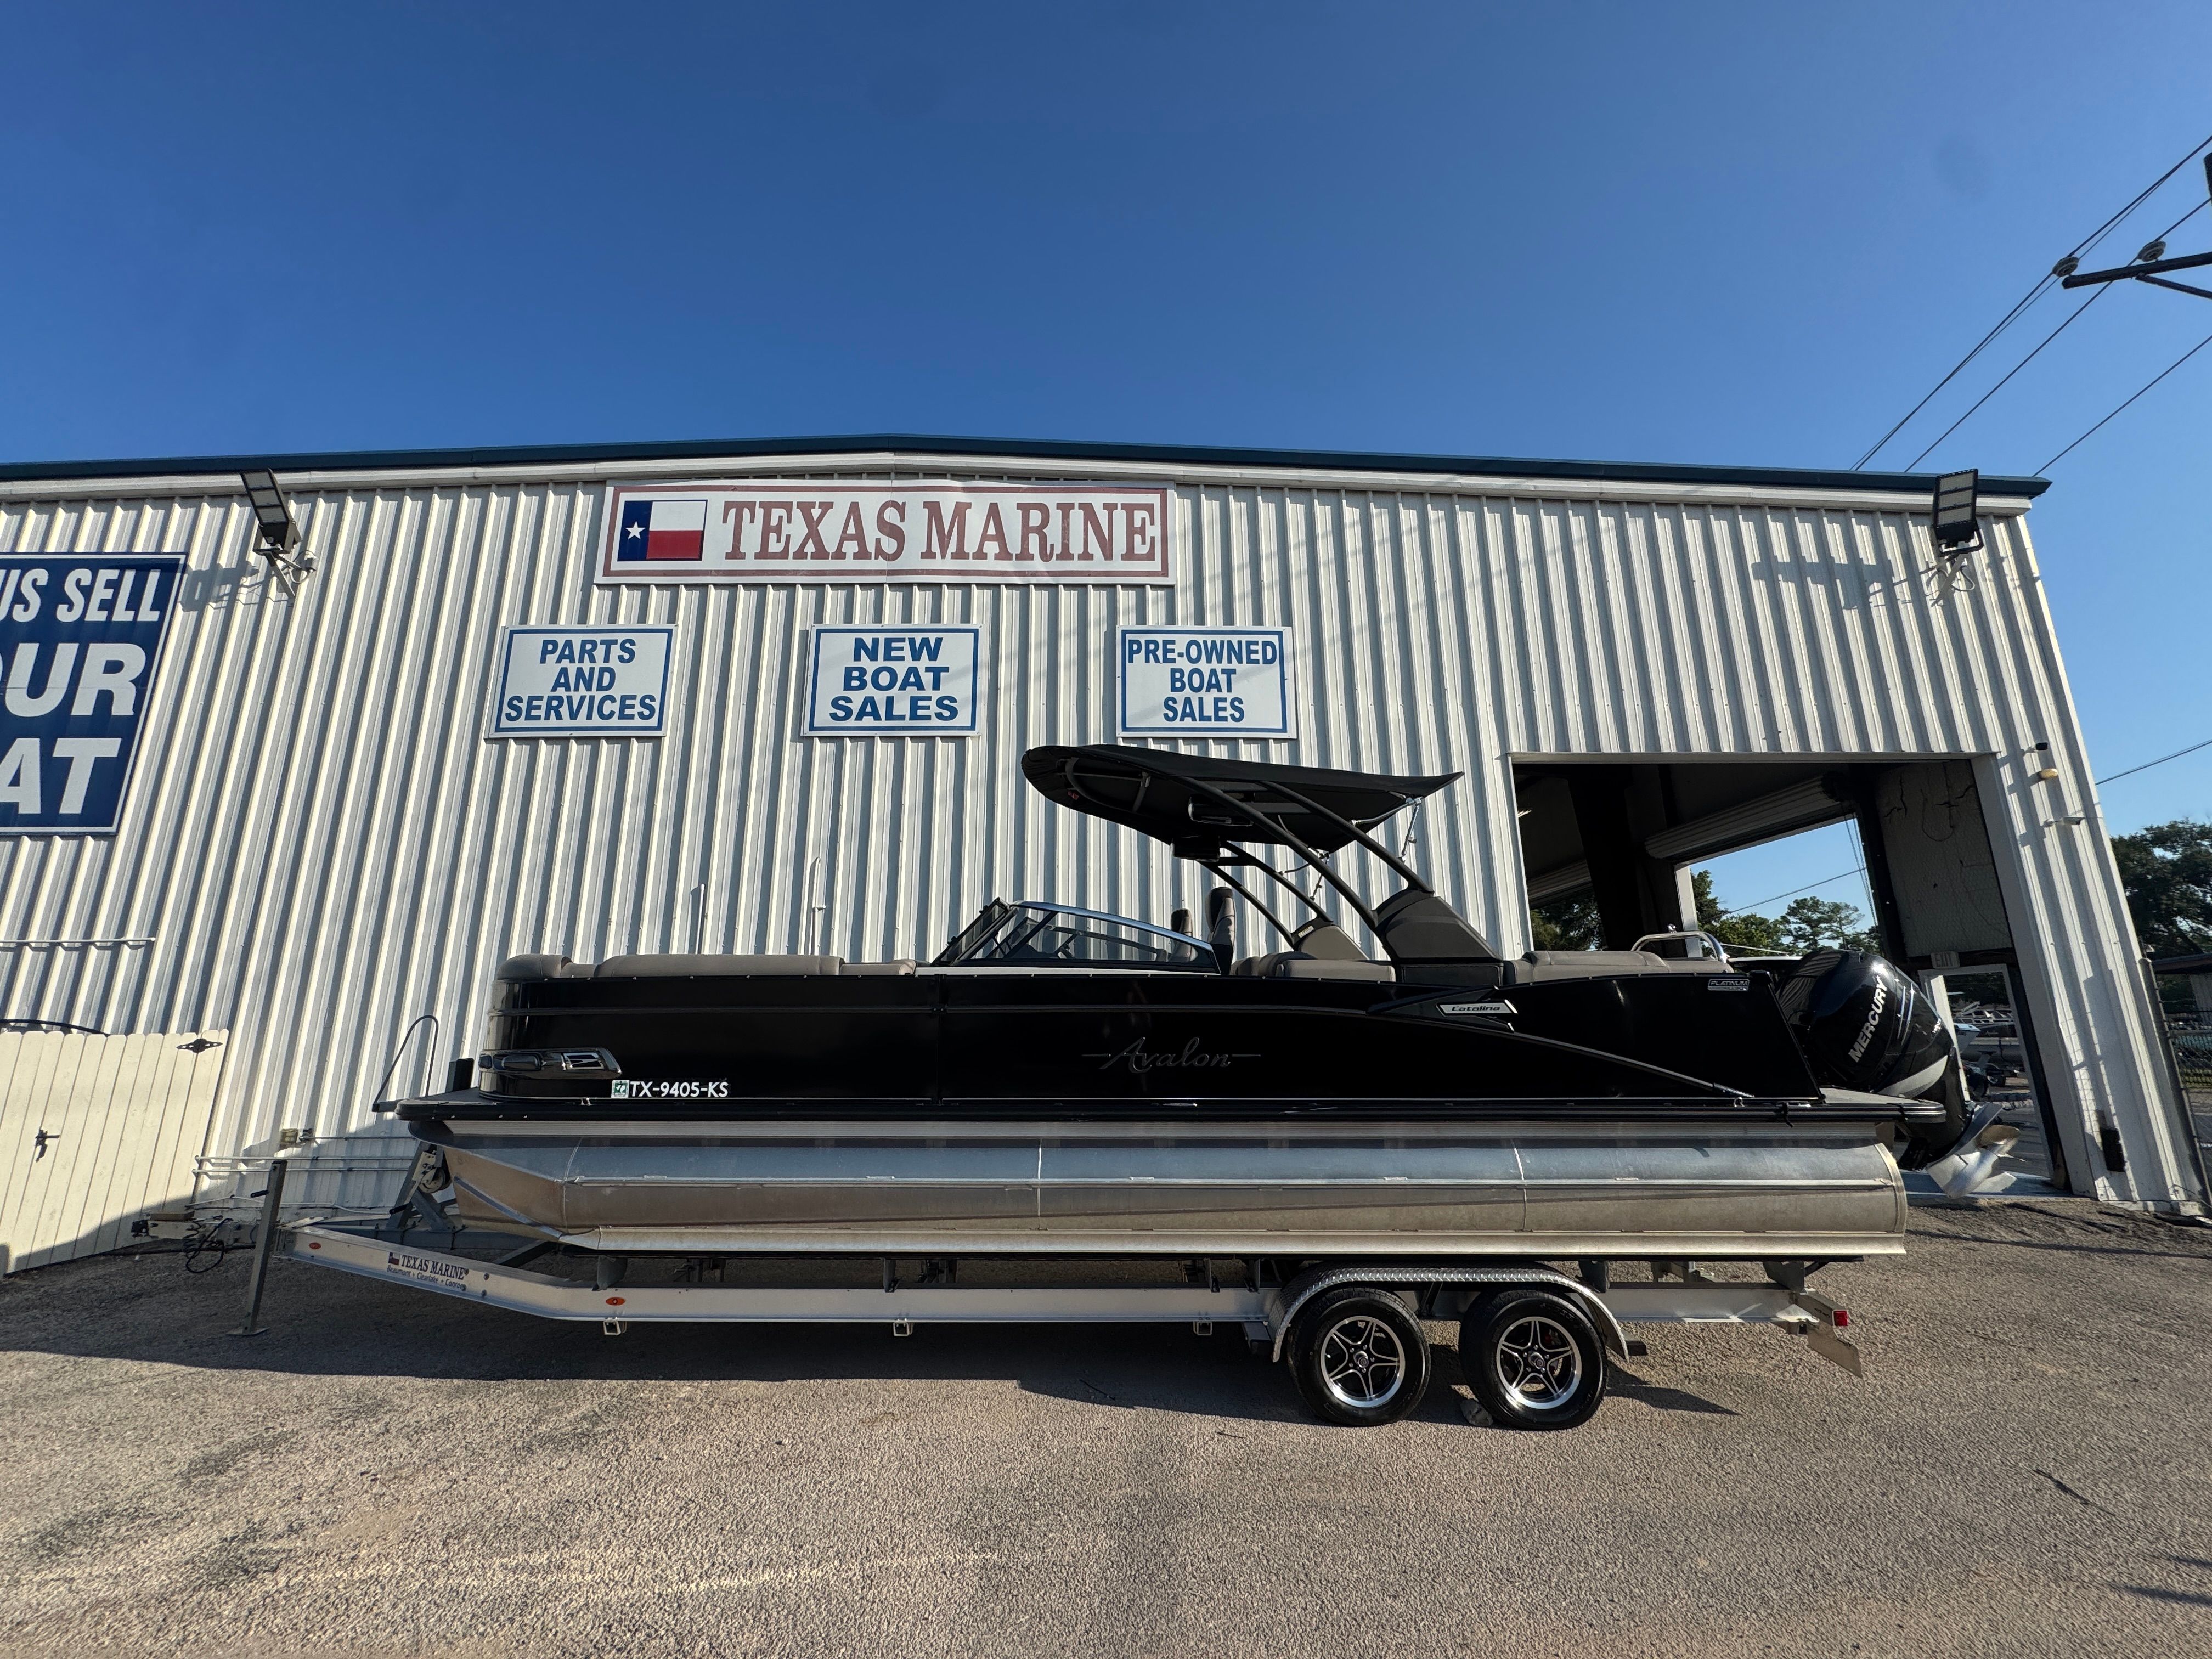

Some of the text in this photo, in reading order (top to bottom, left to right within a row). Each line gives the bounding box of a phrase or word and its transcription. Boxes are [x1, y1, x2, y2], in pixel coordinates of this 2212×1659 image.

[722, 500, 1155, 563] TEXAS MARINE
[56, 568, 161, 622] SELL
[539, 638, 636, 664] PARTS
[853, 637, 944, 662] NEW
[1127, 639, 1278, 665] PRE-OWNED
[0, 642, 146, 717] UR
[551, 666, 616, 693] AND
[843, 666, 950, 692] BOAT
[1170, 668, 1237, 693] BOAT
[505, 694, 657, 722] SERVICES
[829, 695, 958, 722] SALES
[1163, 696, 1245, 723] SALES
[1934, 952, 1953, 967] EXIT
[1848, 975, 1887, 1063] MERCURY
[1098, 1036, 1232, 1074] Avalon
[630, 1081, 729, 1098] TX-9405-KS
[401, 1254, 466, 1280] TEXAS MARINE
[416, 1272, 439, 1284] Clearlake
